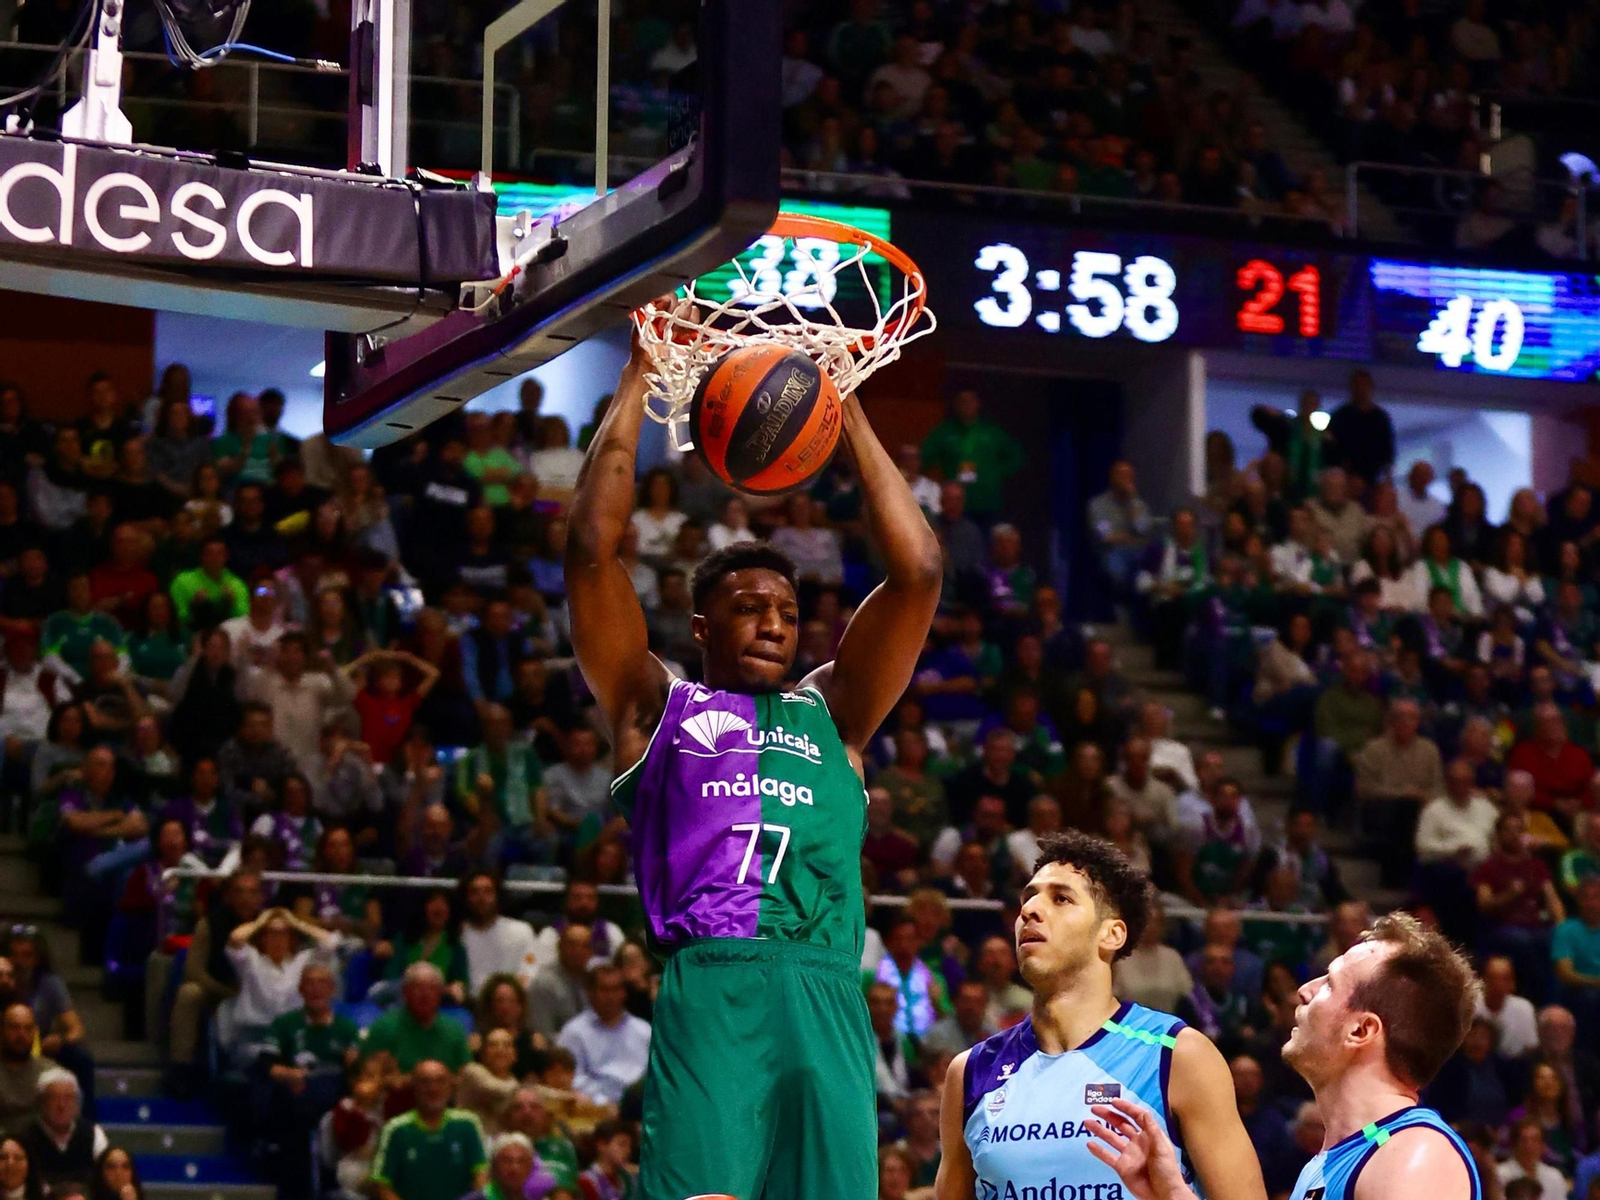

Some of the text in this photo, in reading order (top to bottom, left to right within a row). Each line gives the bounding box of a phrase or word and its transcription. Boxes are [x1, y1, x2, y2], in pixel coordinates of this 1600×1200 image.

[0, 143, 314, 268] desa
[973, 242, 1179, 343] 3:58
[1236, 259, 1320, 337] 21
[1416, 294, 1524, 371] 40
[744, 366, 816, 464] SPALDING
[731, 822, 791, 885] 77
[990, 1120, 1123, 1144] MORABA
